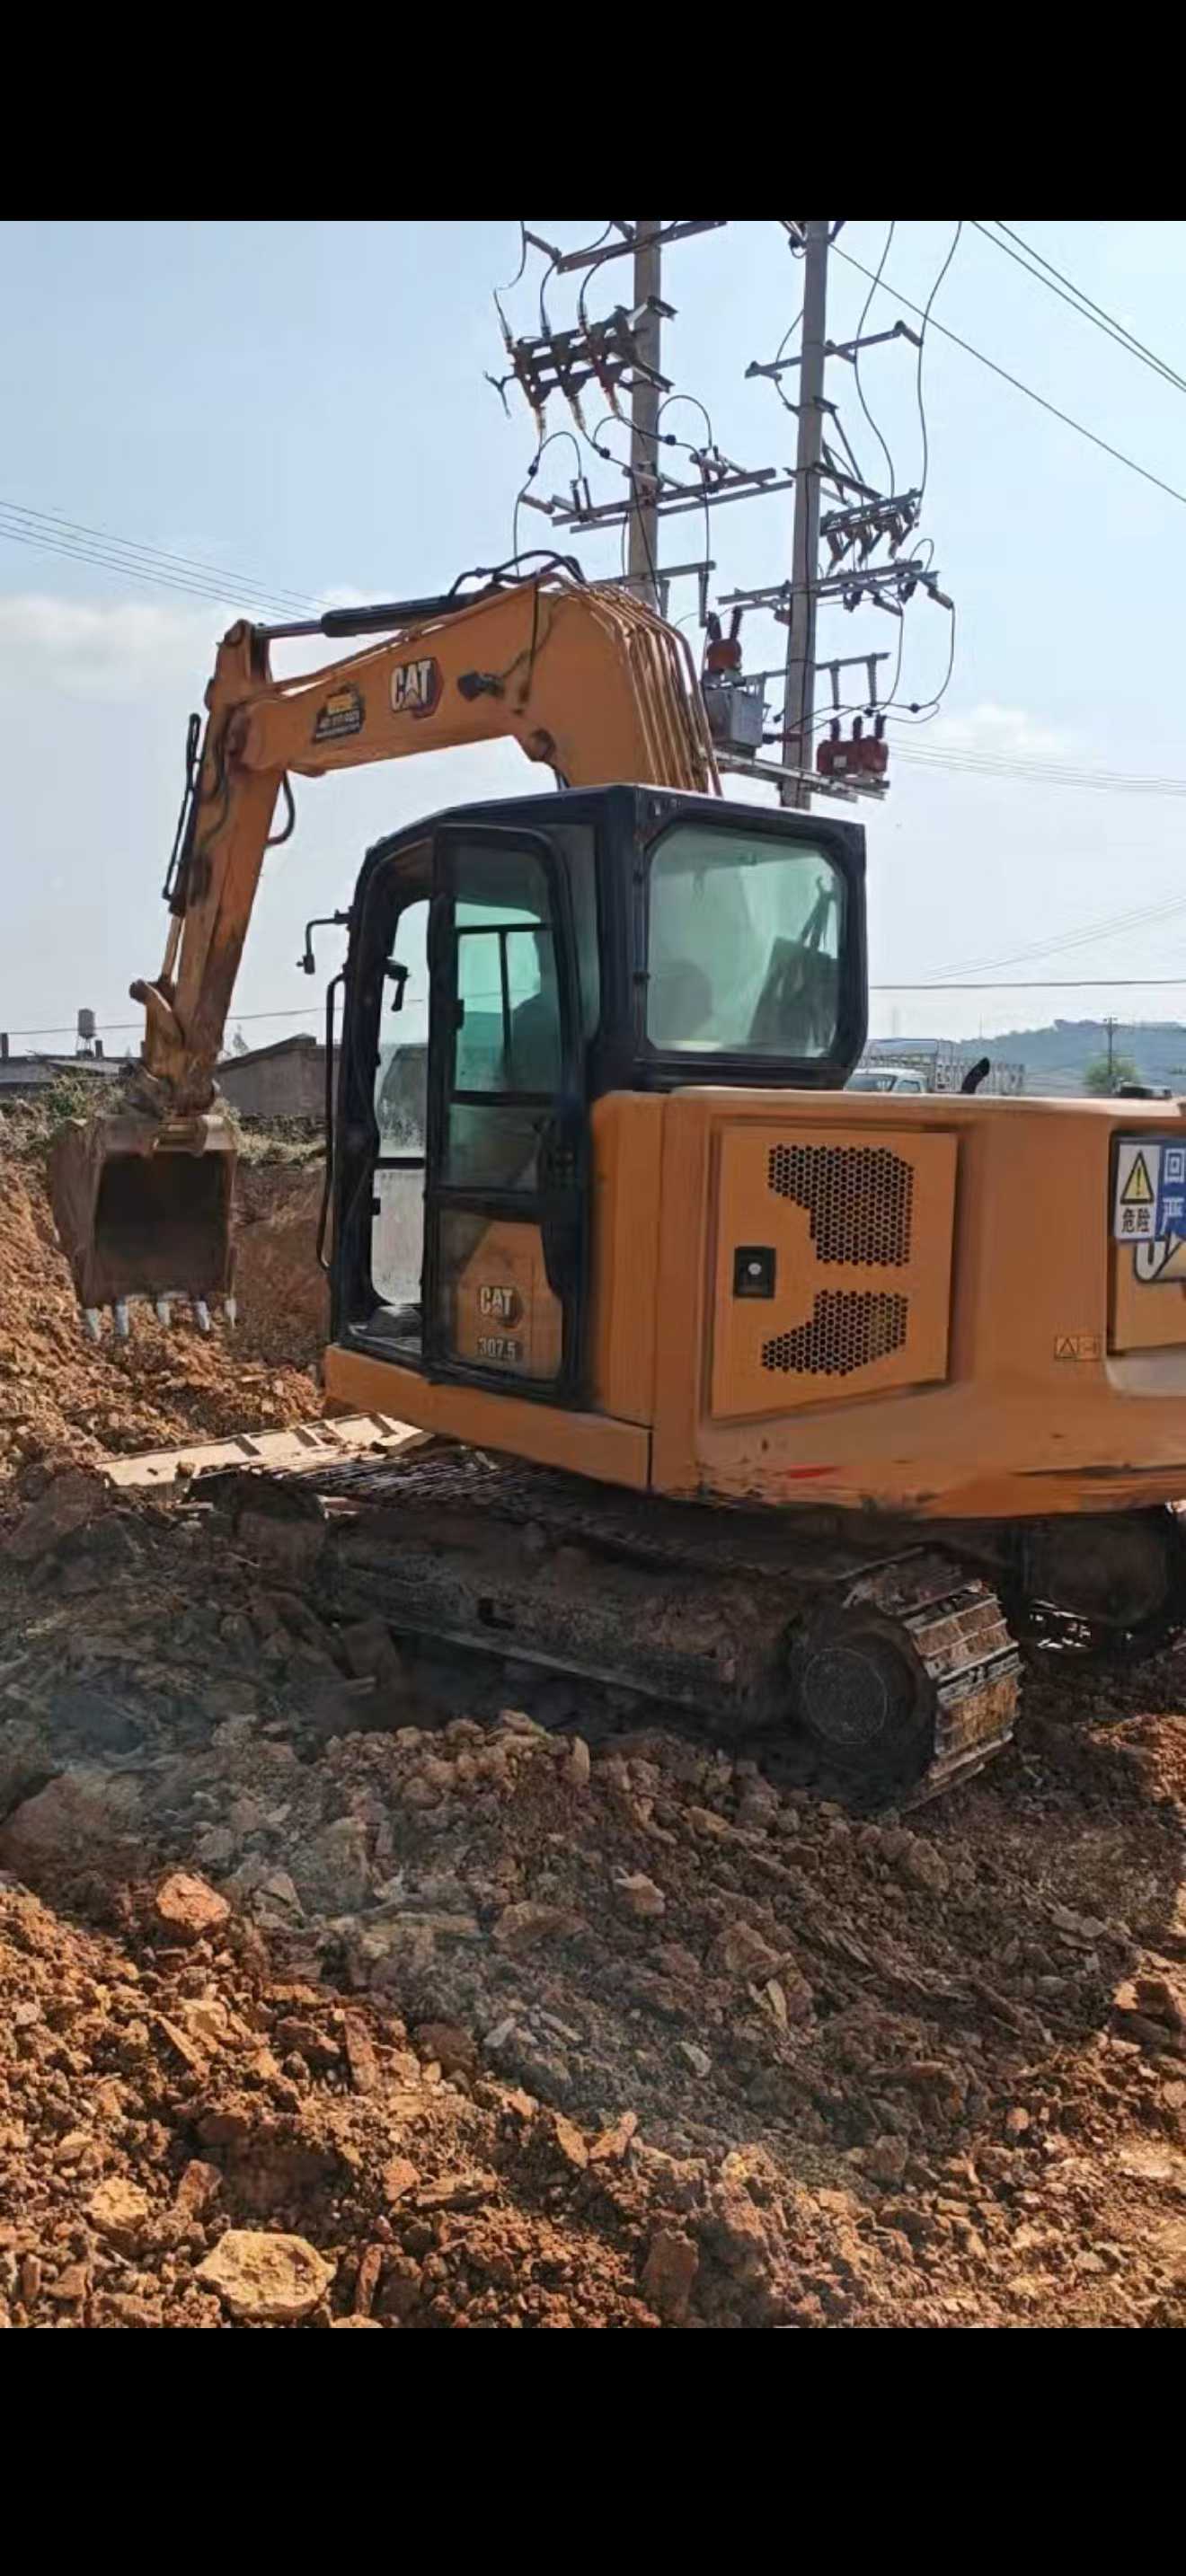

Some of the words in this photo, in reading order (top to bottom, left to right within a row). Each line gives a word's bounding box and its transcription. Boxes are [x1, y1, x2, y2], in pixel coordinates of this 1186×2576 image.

[391, 660, 431, 713] CAT
[1121, 1208, 1150, 1233] 危险
[480, 1285, 513, 1316] CAT
[477, 1337, 516, 1360] 307.5
